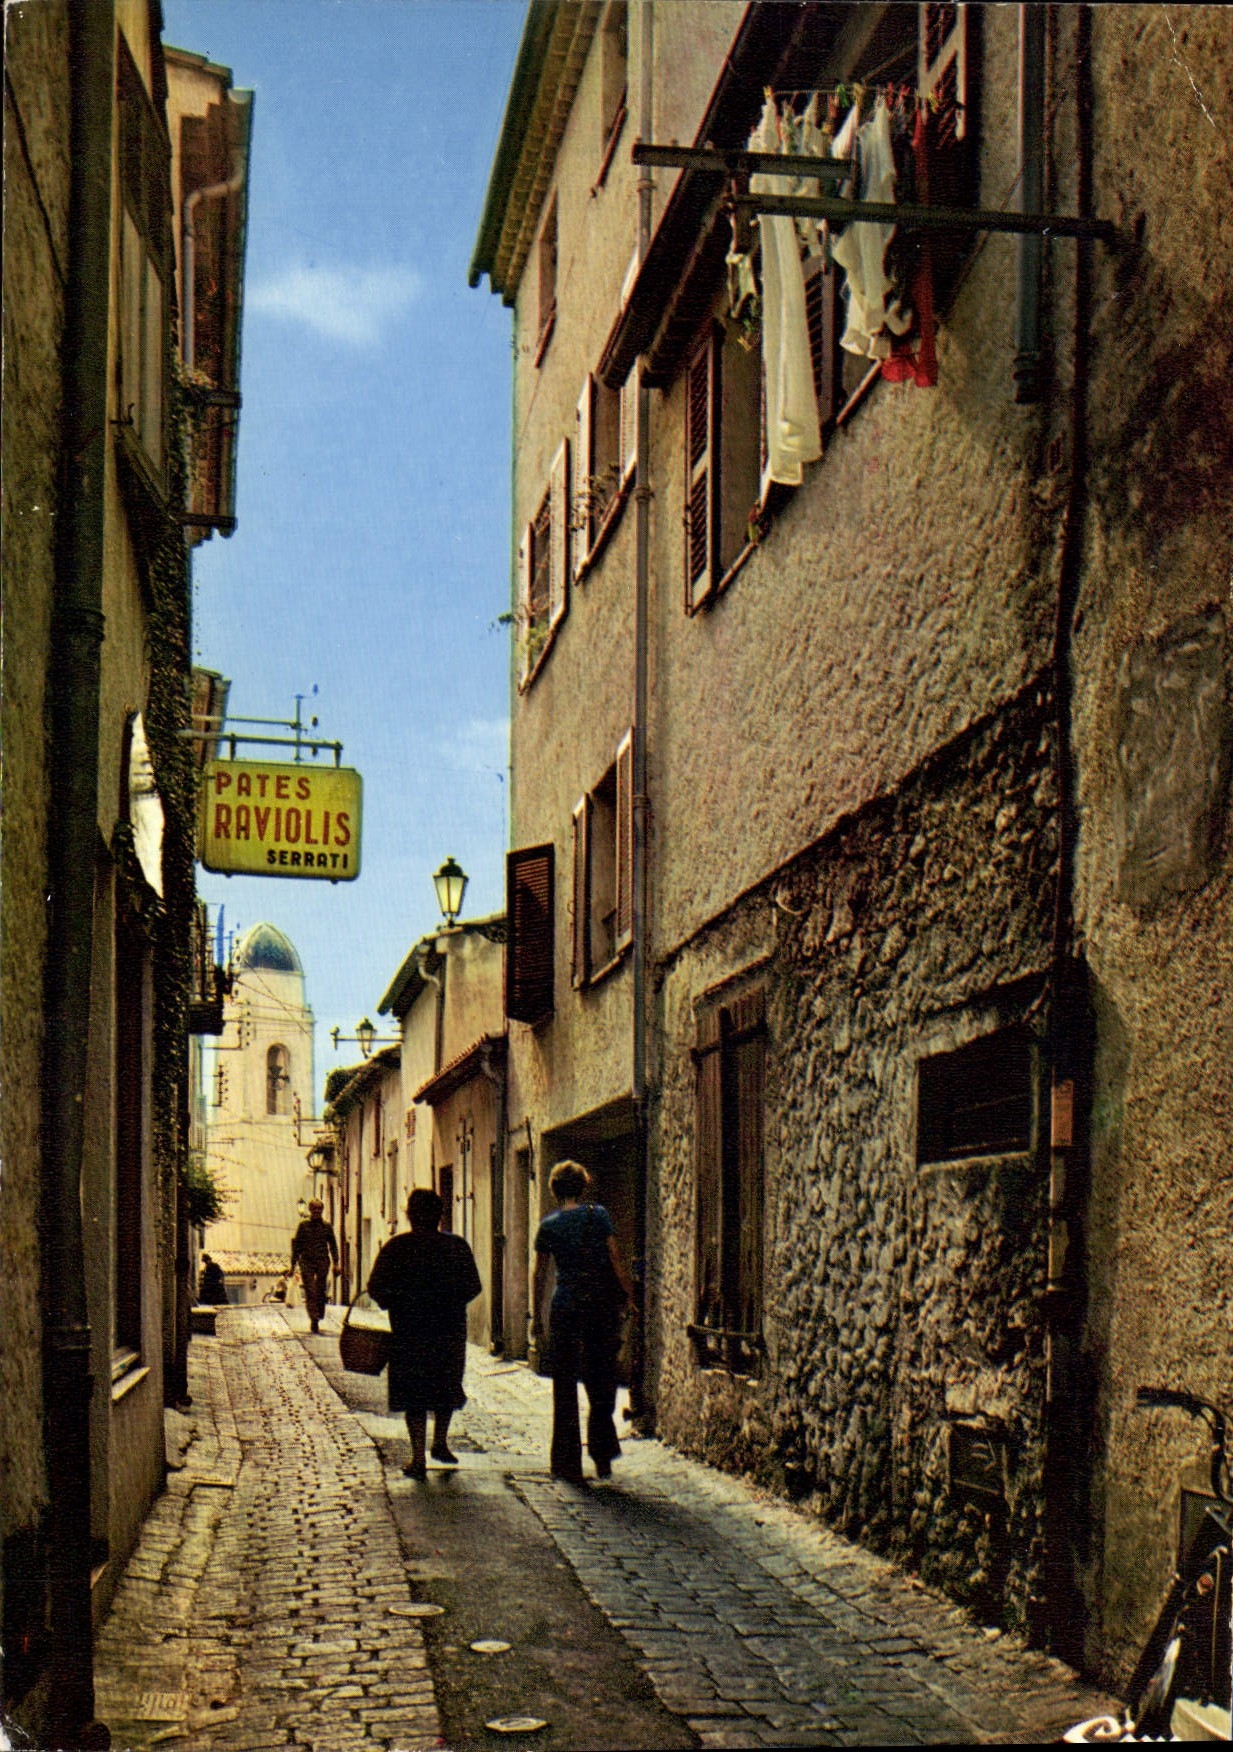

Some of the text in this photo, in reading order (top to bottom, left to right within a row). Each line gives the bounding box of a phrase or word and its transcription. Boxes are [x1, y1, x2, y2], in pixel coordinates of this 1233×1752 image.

[214, 771, 311, 800] PATES
[214, 803, 351, 847] RAVIOLIS
[266, 849, 348, 869] SERRATI
